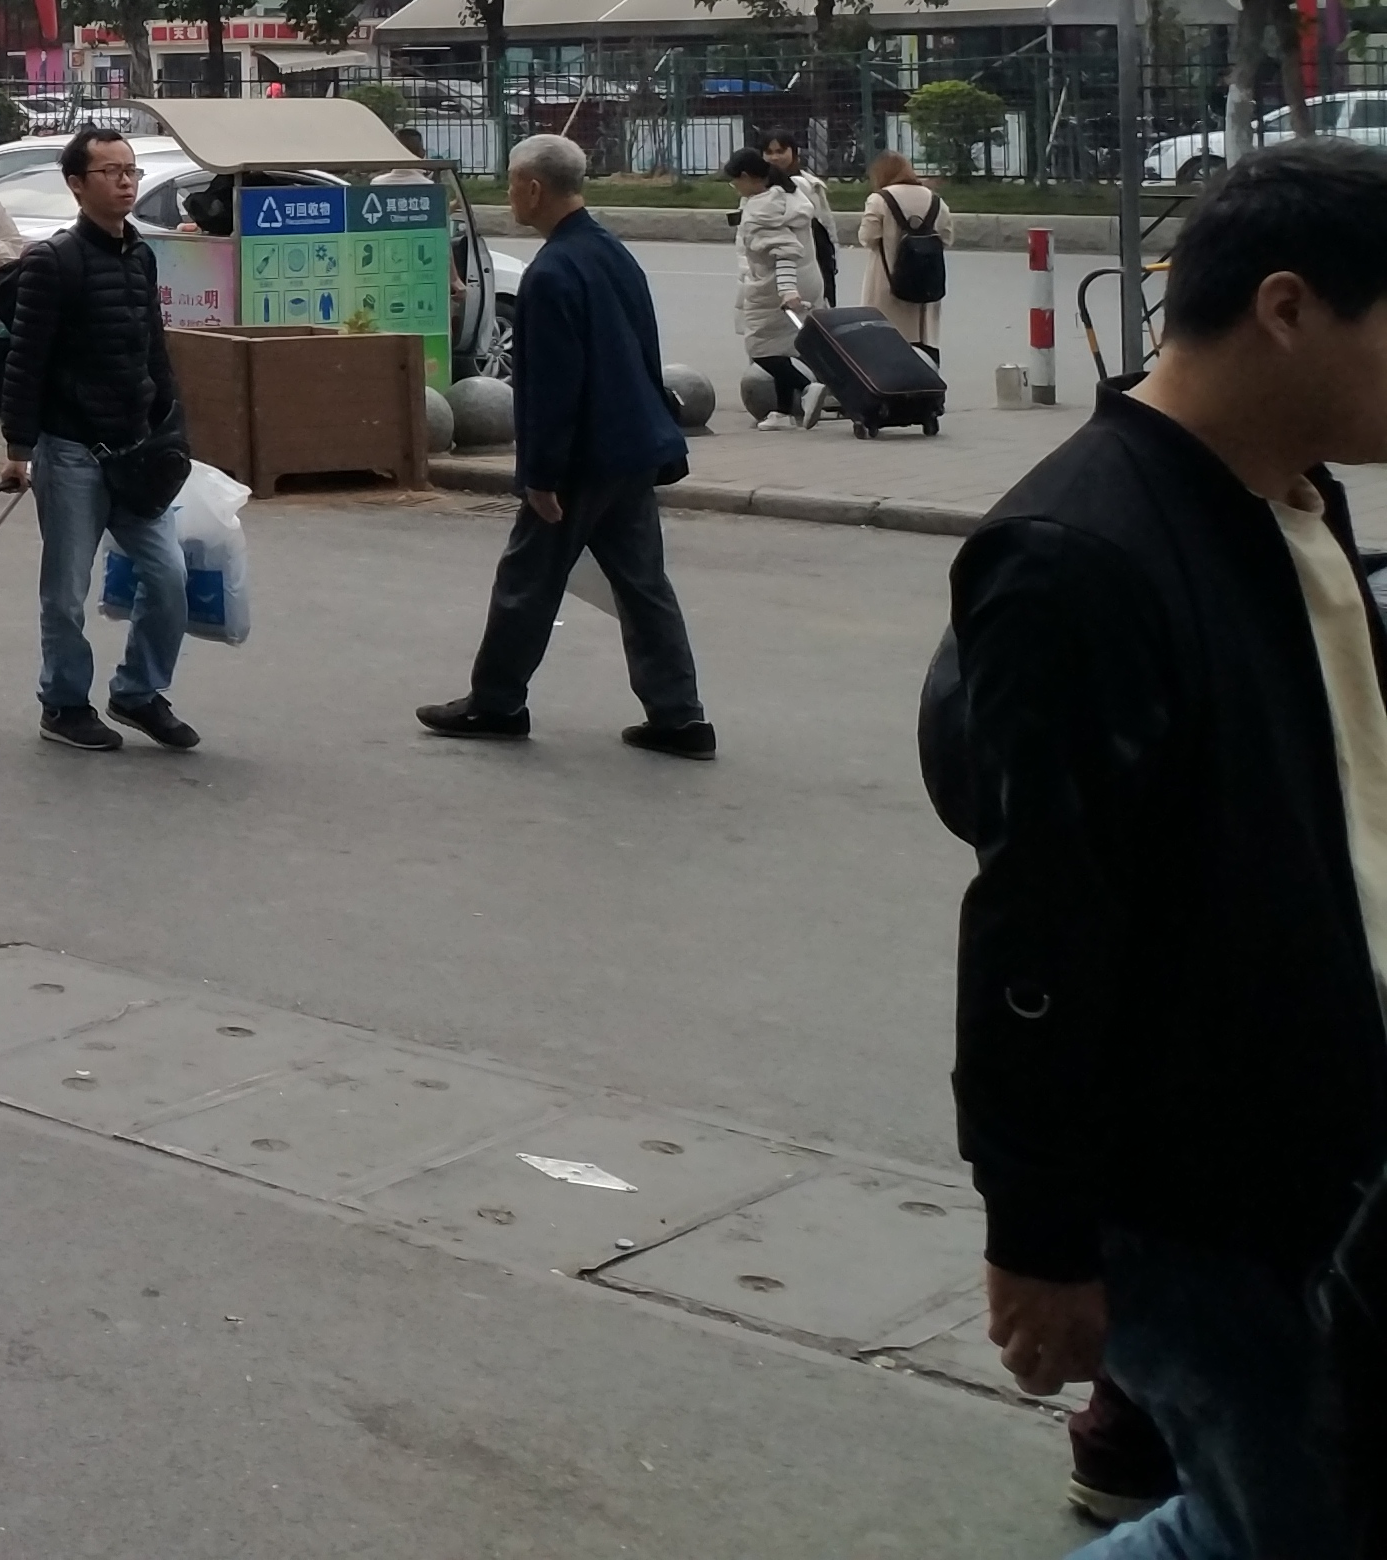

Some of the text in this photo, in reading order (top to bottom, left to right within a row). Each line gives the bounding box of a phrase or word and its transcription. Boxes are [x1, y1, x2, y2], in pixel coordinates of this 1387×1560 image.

[284, 201, 331, 217] 可回收物
[386, 196, 431, 212] 其他垃圾
